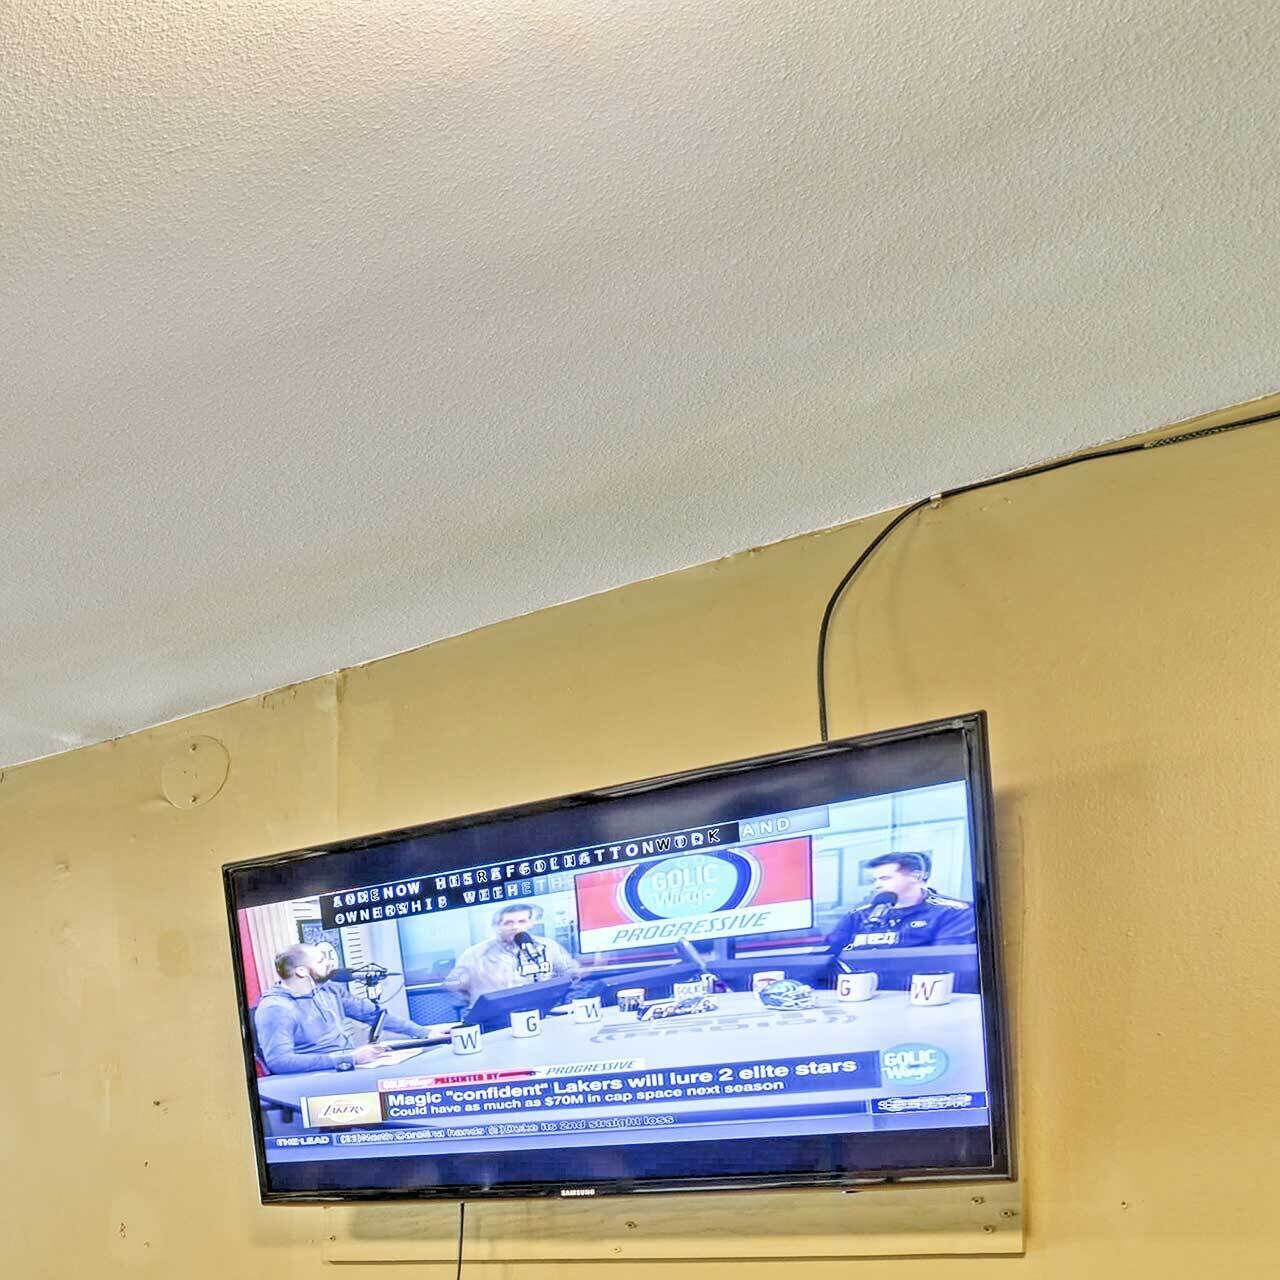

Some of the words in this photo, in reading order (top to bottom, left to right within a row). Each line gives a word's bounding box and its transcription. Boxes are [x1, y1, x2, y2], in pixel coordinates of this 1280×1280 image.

[741, 817, 790, 838] AND
[611, 911, 772, 944] PROGRESSIVE
[546, 1060, 636, 1076] PROGRESSIVE
[388, 1091, 442, 1107] Magic
[446, 1083, 549, 1102] "confident"
[554, 1077, 623, 1095] Lakers
[628, 1073, 664, 1089] will
[670, 1069, 714, 1086] lure
[718, 1067, 734, 1082] 2
[738, 1063, 790, 1081] elite
[795, 1060, 858, 1077] stars
[390, 1105, 427, 1118] Could
[430, 1102, 462, 1114] have
[465, 1102, 481, 1113] as
[483, 1099, 522, 1111] much
[525, 1099, 540, 1109] as
[545, 1093, 585, 1108] $70M
[587, 1092, 601, 1104] in
[605, 1091, 633, 1105] cap
[636, 1087, 683, 1102] space
[686, 1084, 721, 1097] next
[724, 1080, 785, 1095] season
[644, 1115, 675, 1126] loss
[561, 1189, 596, 1197] SAMSUNG
